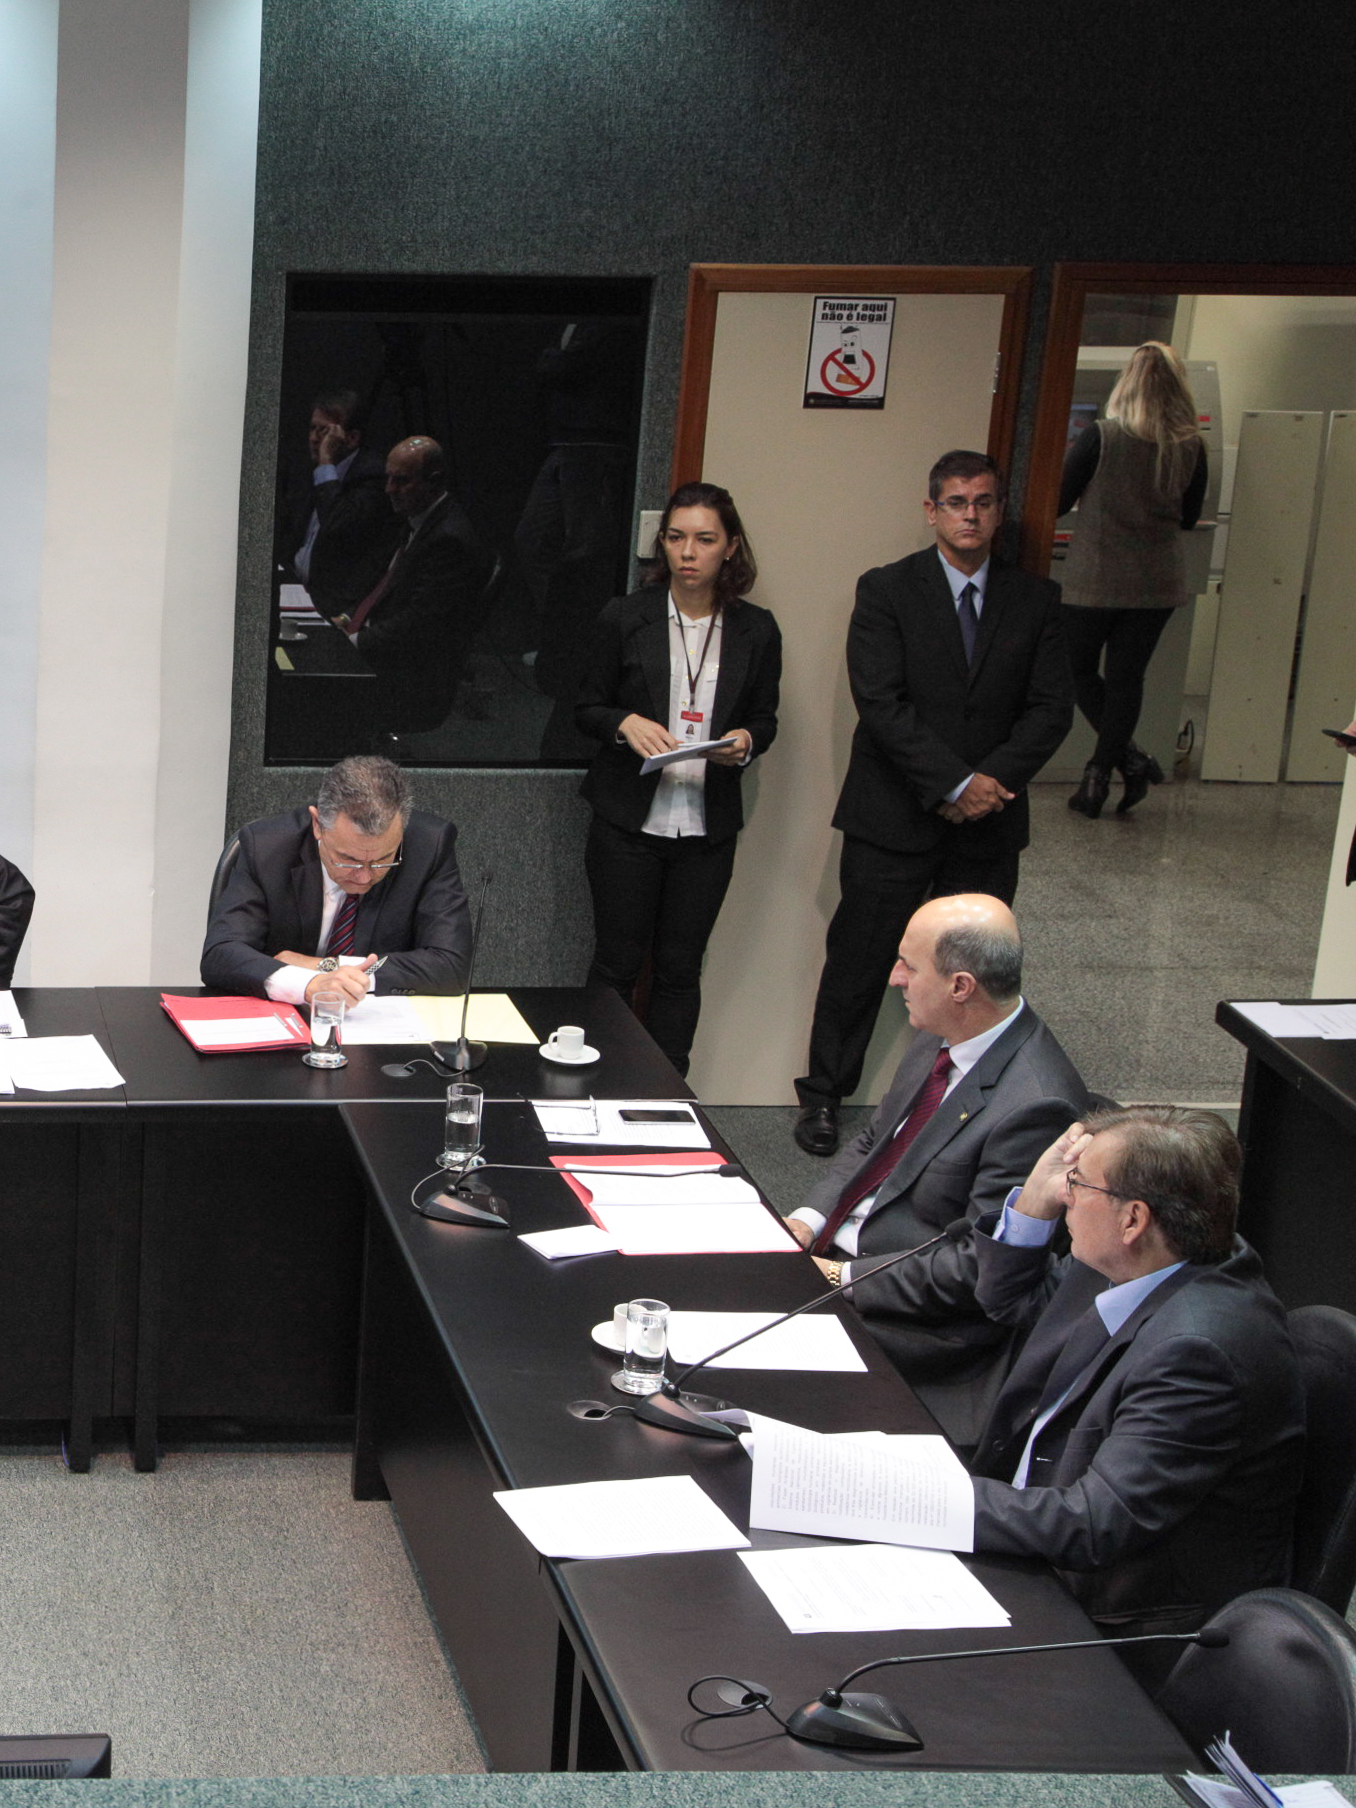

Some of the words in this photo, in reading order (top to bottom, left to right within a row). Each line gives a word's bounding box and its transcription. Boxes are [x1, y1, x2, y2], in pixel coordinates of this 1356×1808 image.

[822, 301, 860, 312] Fumar
[861, 302, 888, 313] aqui
[821, 310, 844, 321] não
[846, 310, 854, 321] é
[855, 312, 887, 323] legal
